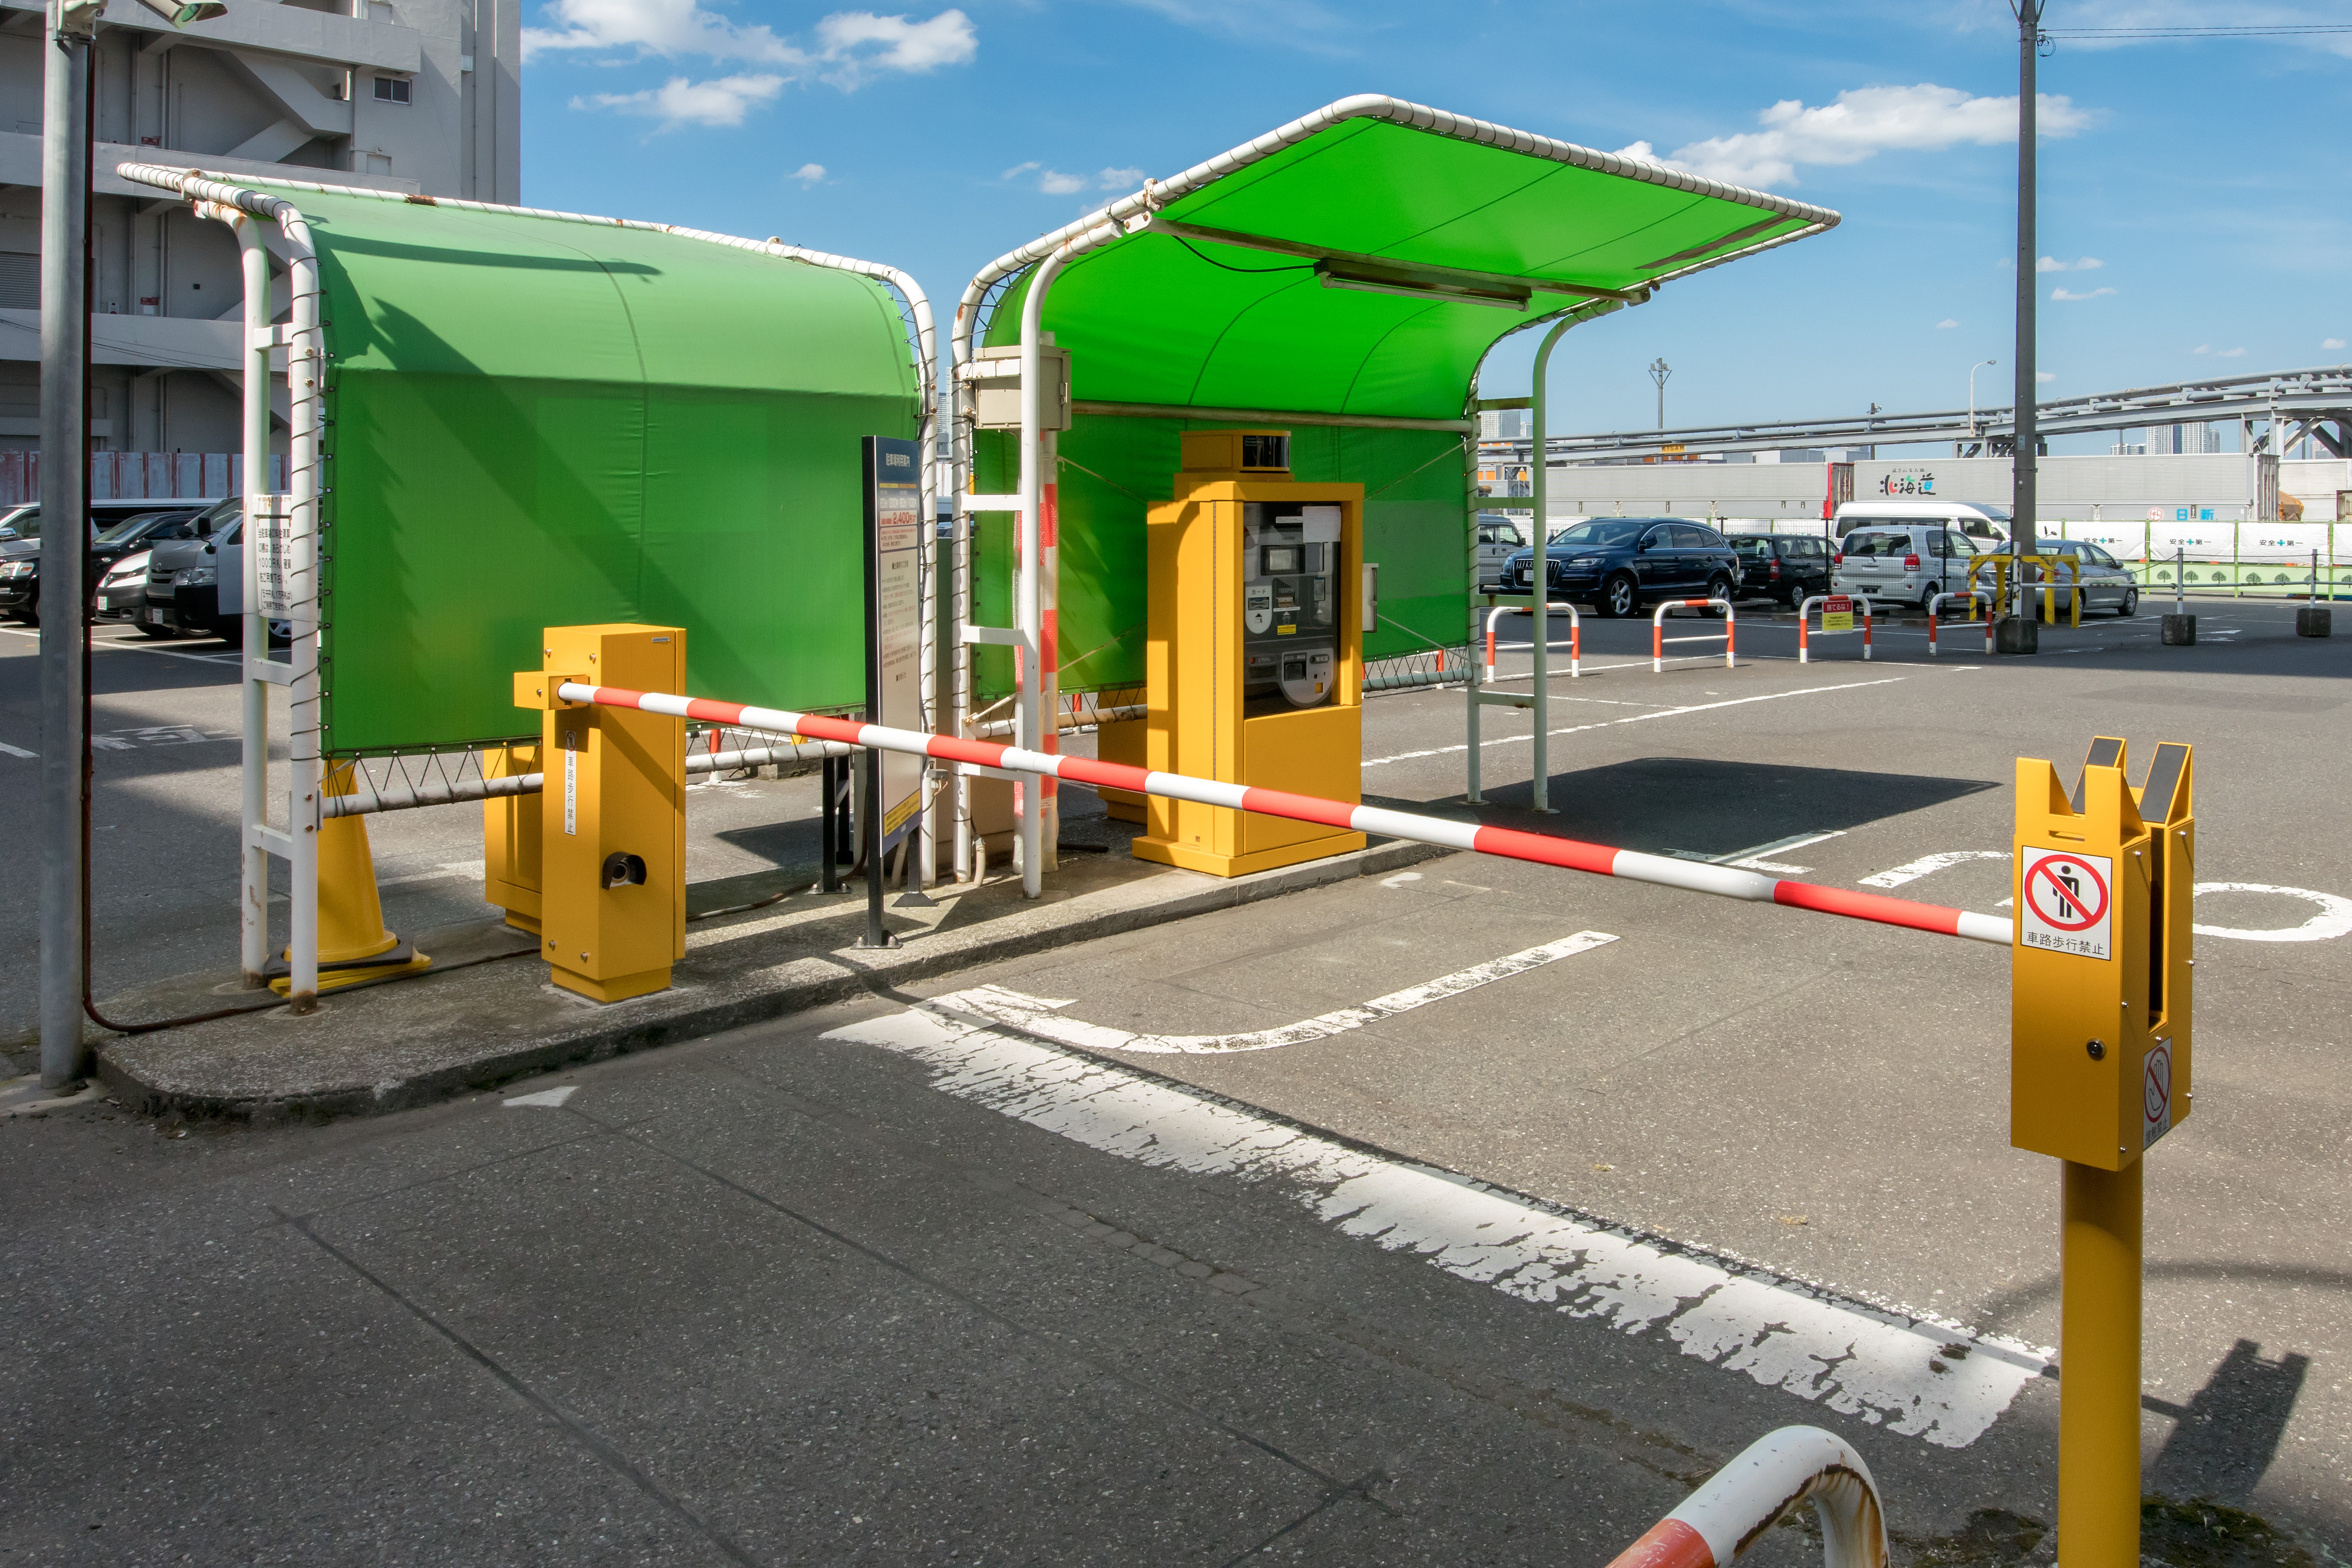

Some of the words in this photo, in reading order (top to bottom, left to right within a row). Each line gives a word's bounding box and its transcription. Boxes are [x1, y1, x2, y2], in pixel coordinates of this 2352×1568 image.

[1880, 473, 1936, 496] 北海道
[2026, 931, 2104, 956] 車路歩行禁止
